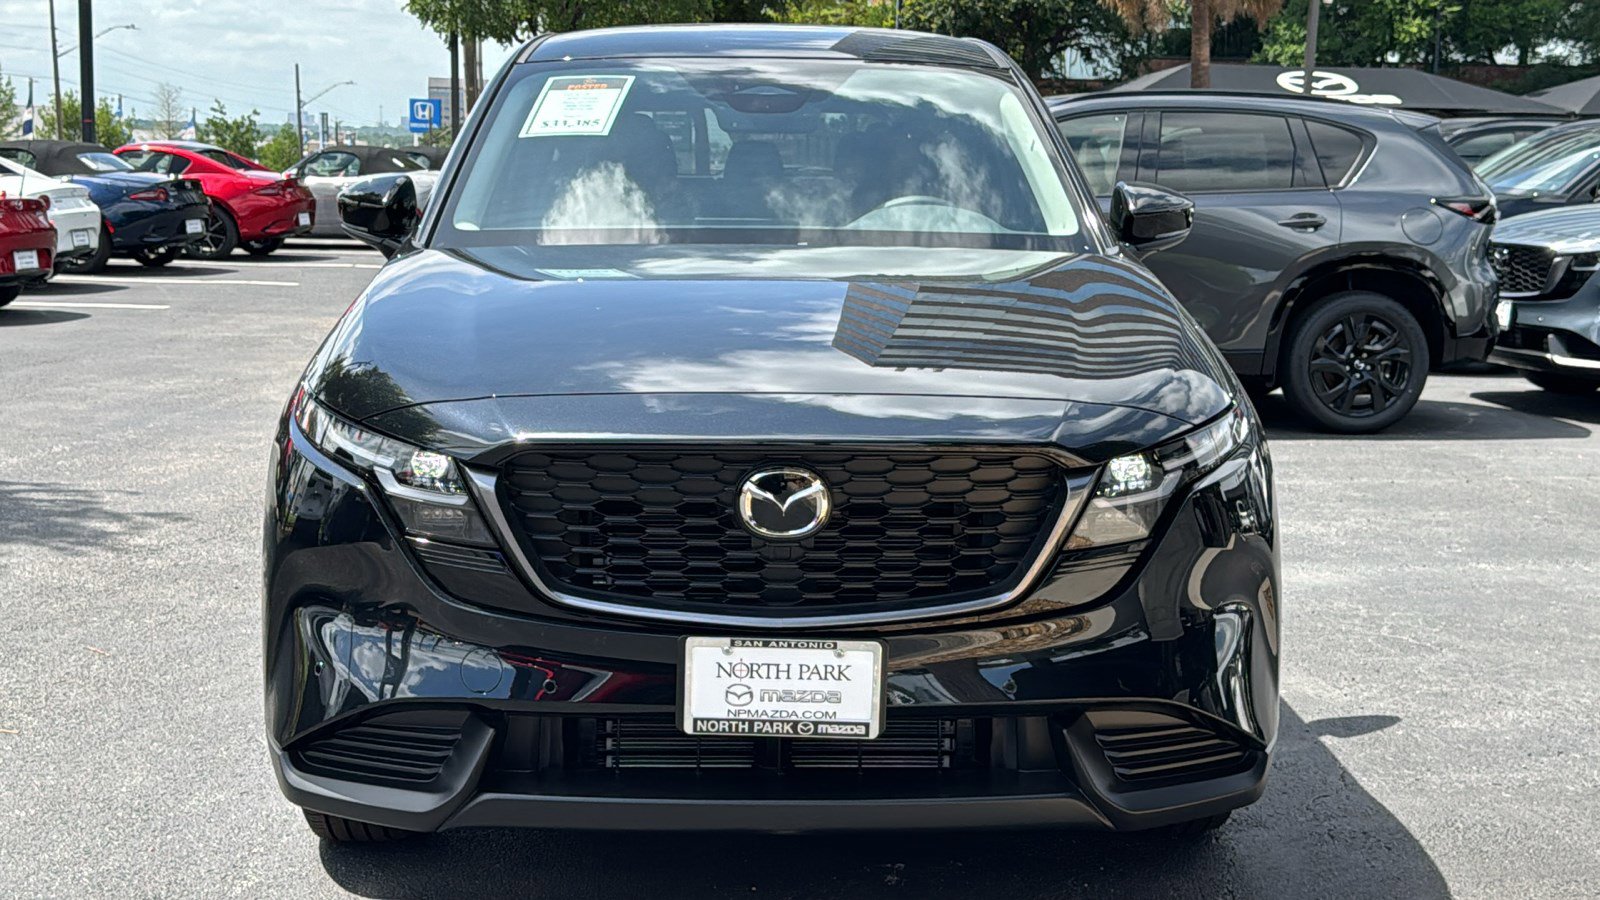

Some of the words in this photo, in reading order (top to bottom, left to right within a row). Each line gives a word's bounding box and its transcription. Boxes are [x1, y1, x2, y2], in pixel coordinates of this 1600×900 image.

[770, 641, 835, 649] ANTONIO
[716, 660, 791, 681] NORTH
[798, 664, 852, 681] PARK
[760, 689, 842, 704] mazda
[727, 709, 837, 720] NPMAZDA.COM
[696, 720, 749, 733] NORTH
[753, 721, 794, 734] PARK
[817, 724, 866, 735] mazda
